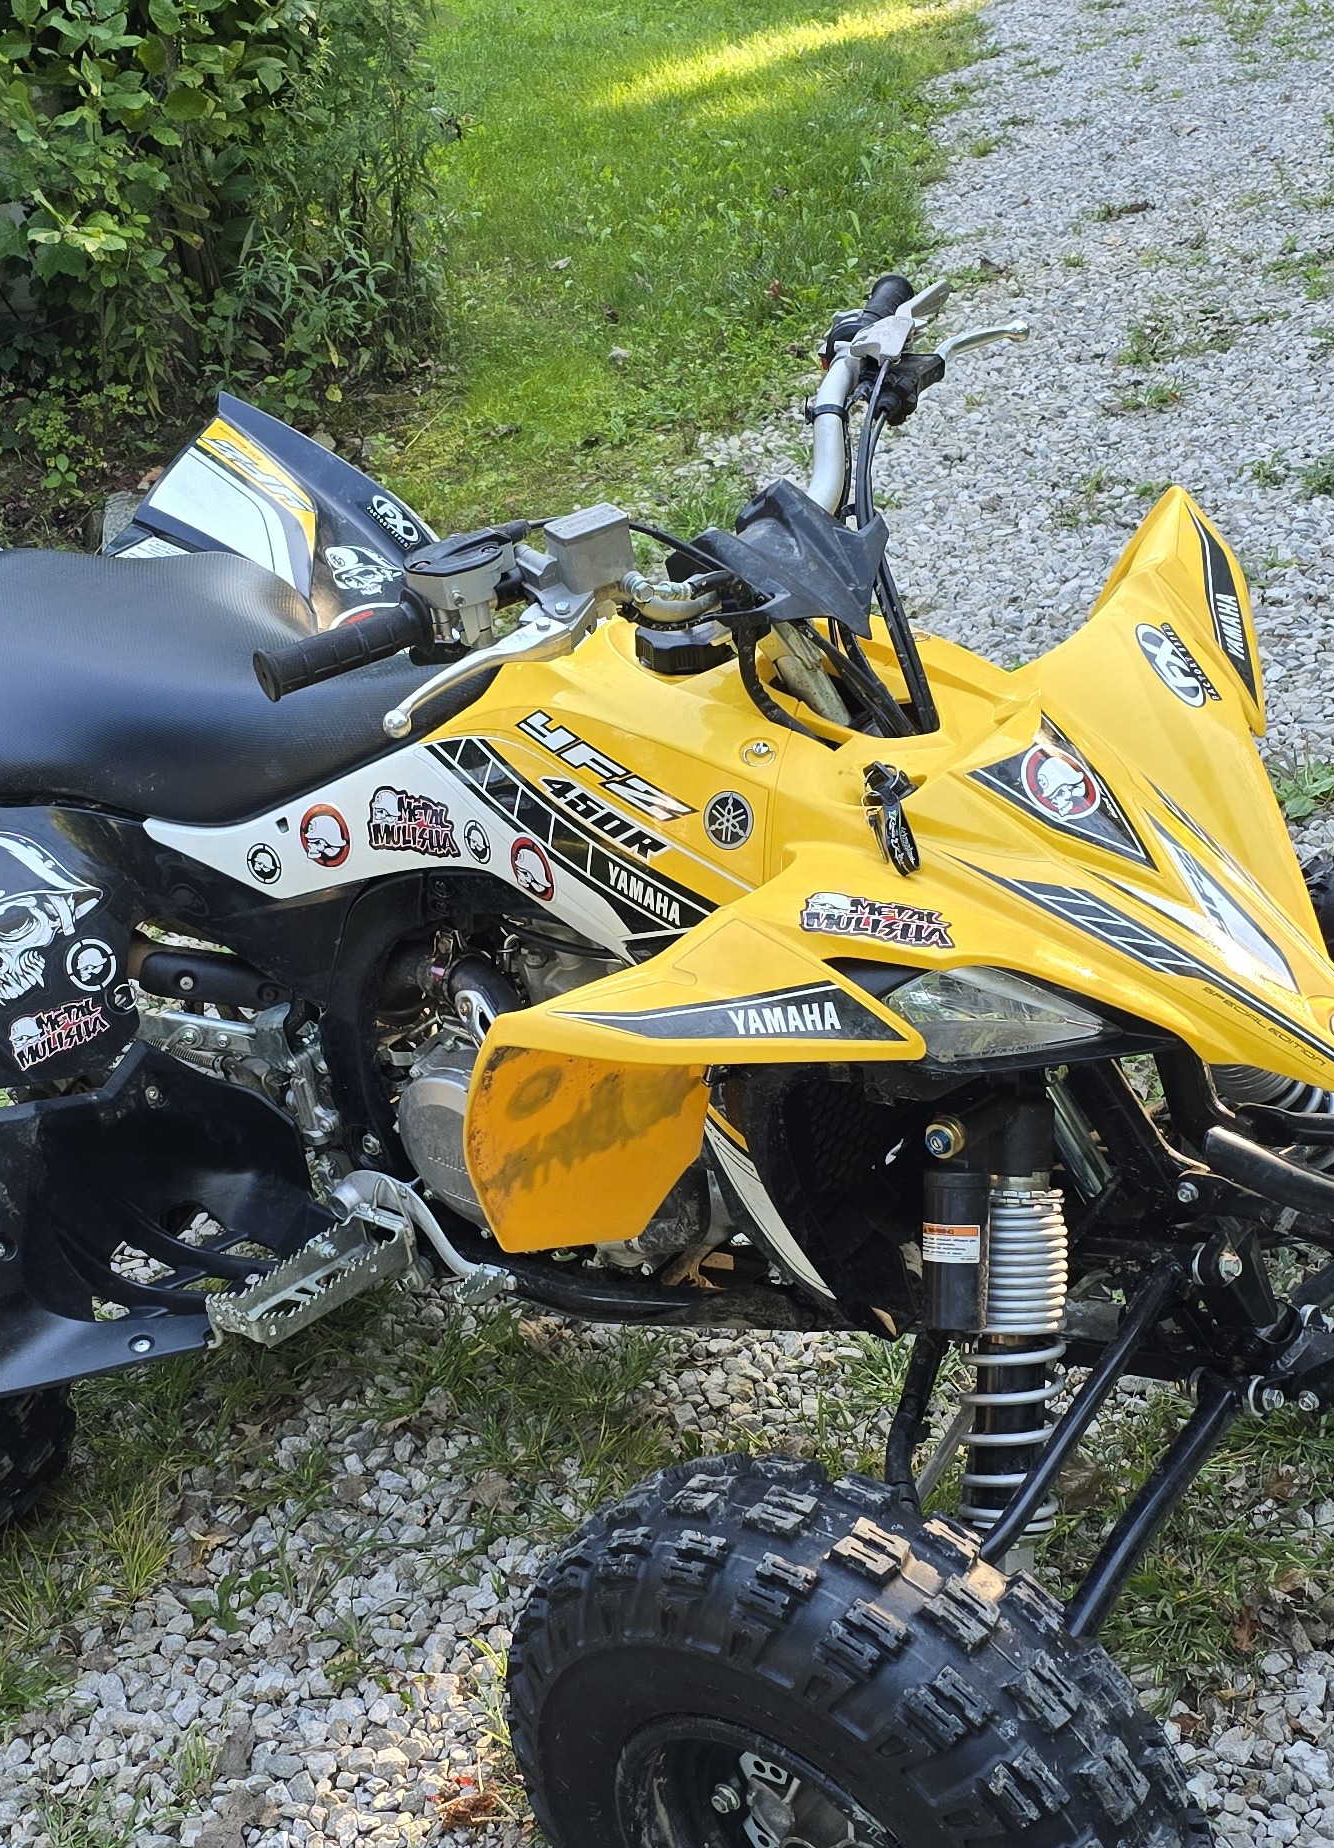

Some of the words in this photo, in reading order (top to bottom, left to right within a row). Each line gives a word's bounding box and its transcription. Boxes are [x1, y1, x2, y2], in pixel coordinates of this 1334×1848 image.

[1215, 593, 1245, 660] YAMAHA
[517, 710, 699, 822] YFZ
[540, 778, 669, 859] 450R
[607, 862, 681, 926] YAMAHA
[849, 897, 951, 927] METAL
[727, 1001, 842, 1035] YAMAHA
[1201, 985, 1267, 1030] SPECIAL
[1267, 1026, 1327, 1067] EDITION
